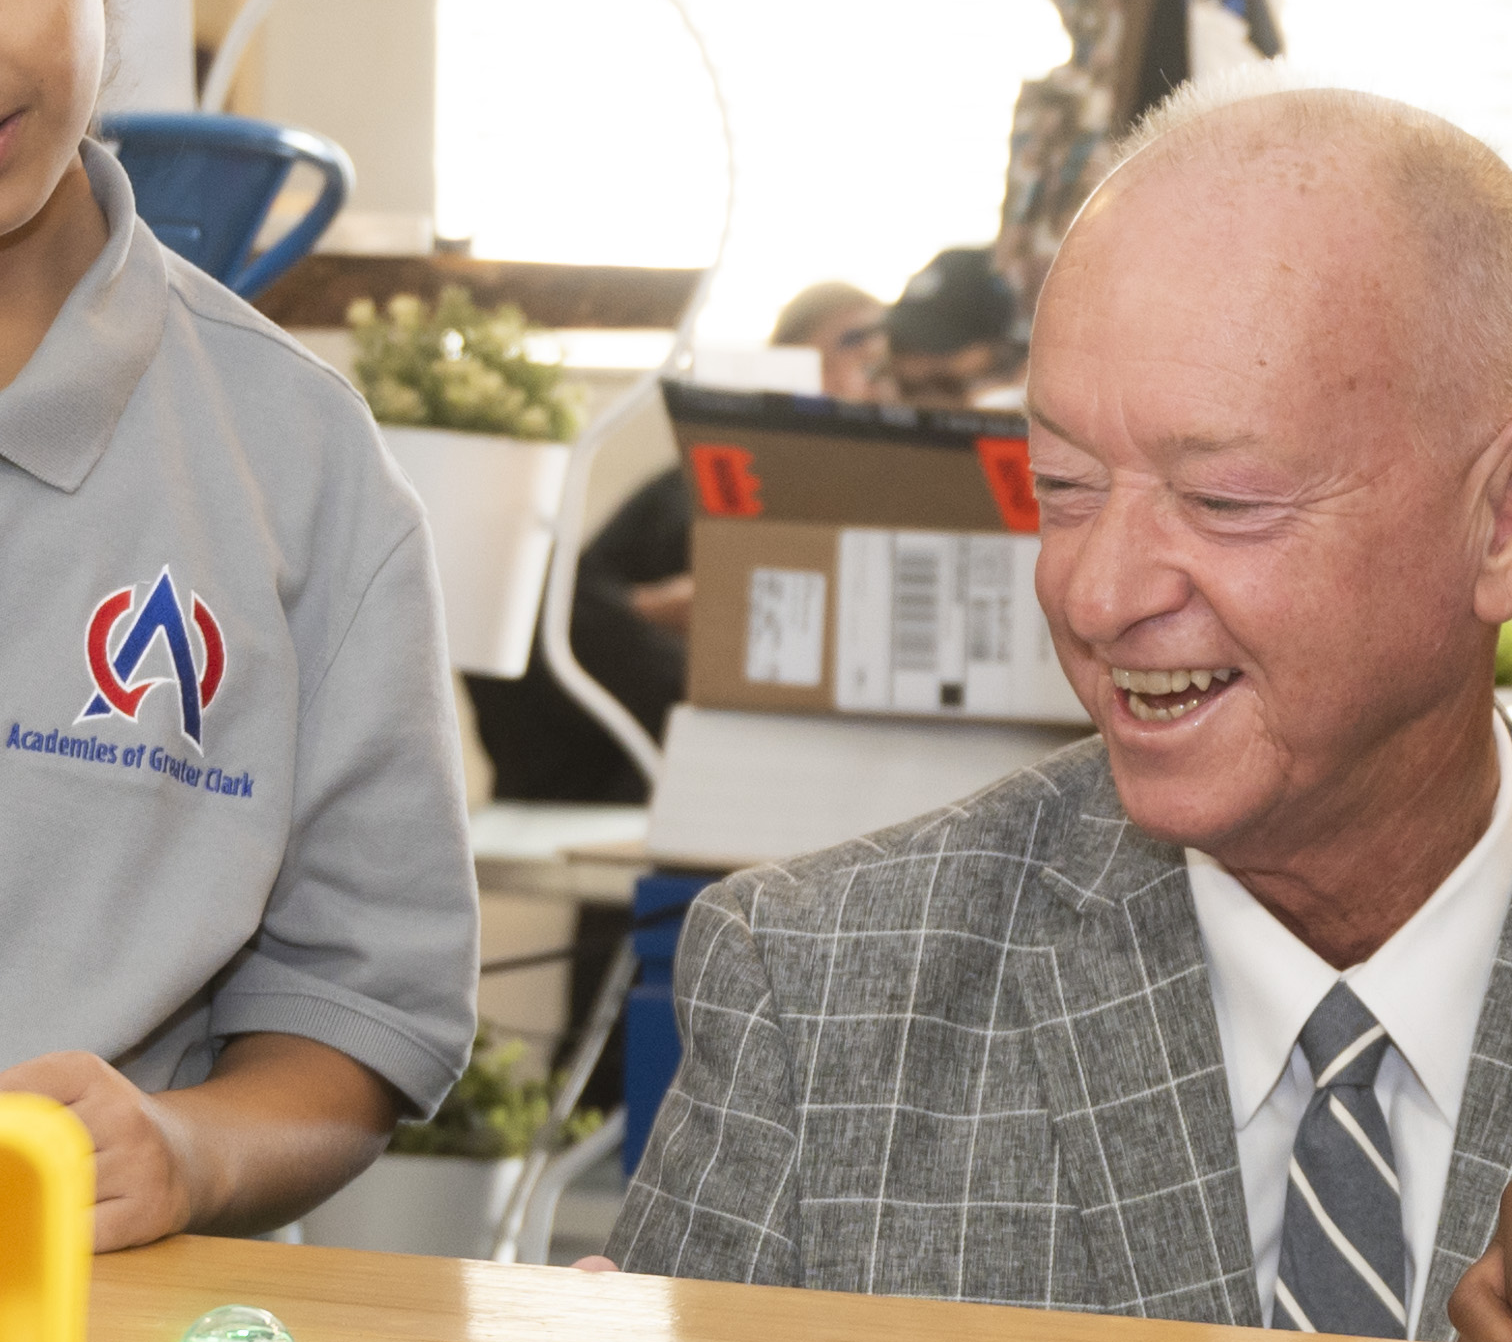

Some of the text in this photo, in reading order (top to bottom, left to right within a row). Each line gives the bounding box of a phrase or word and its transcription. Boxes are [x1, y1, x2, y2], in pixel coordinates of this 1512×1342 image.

[6, 722, 255, 798] Academies of Greater Clark
